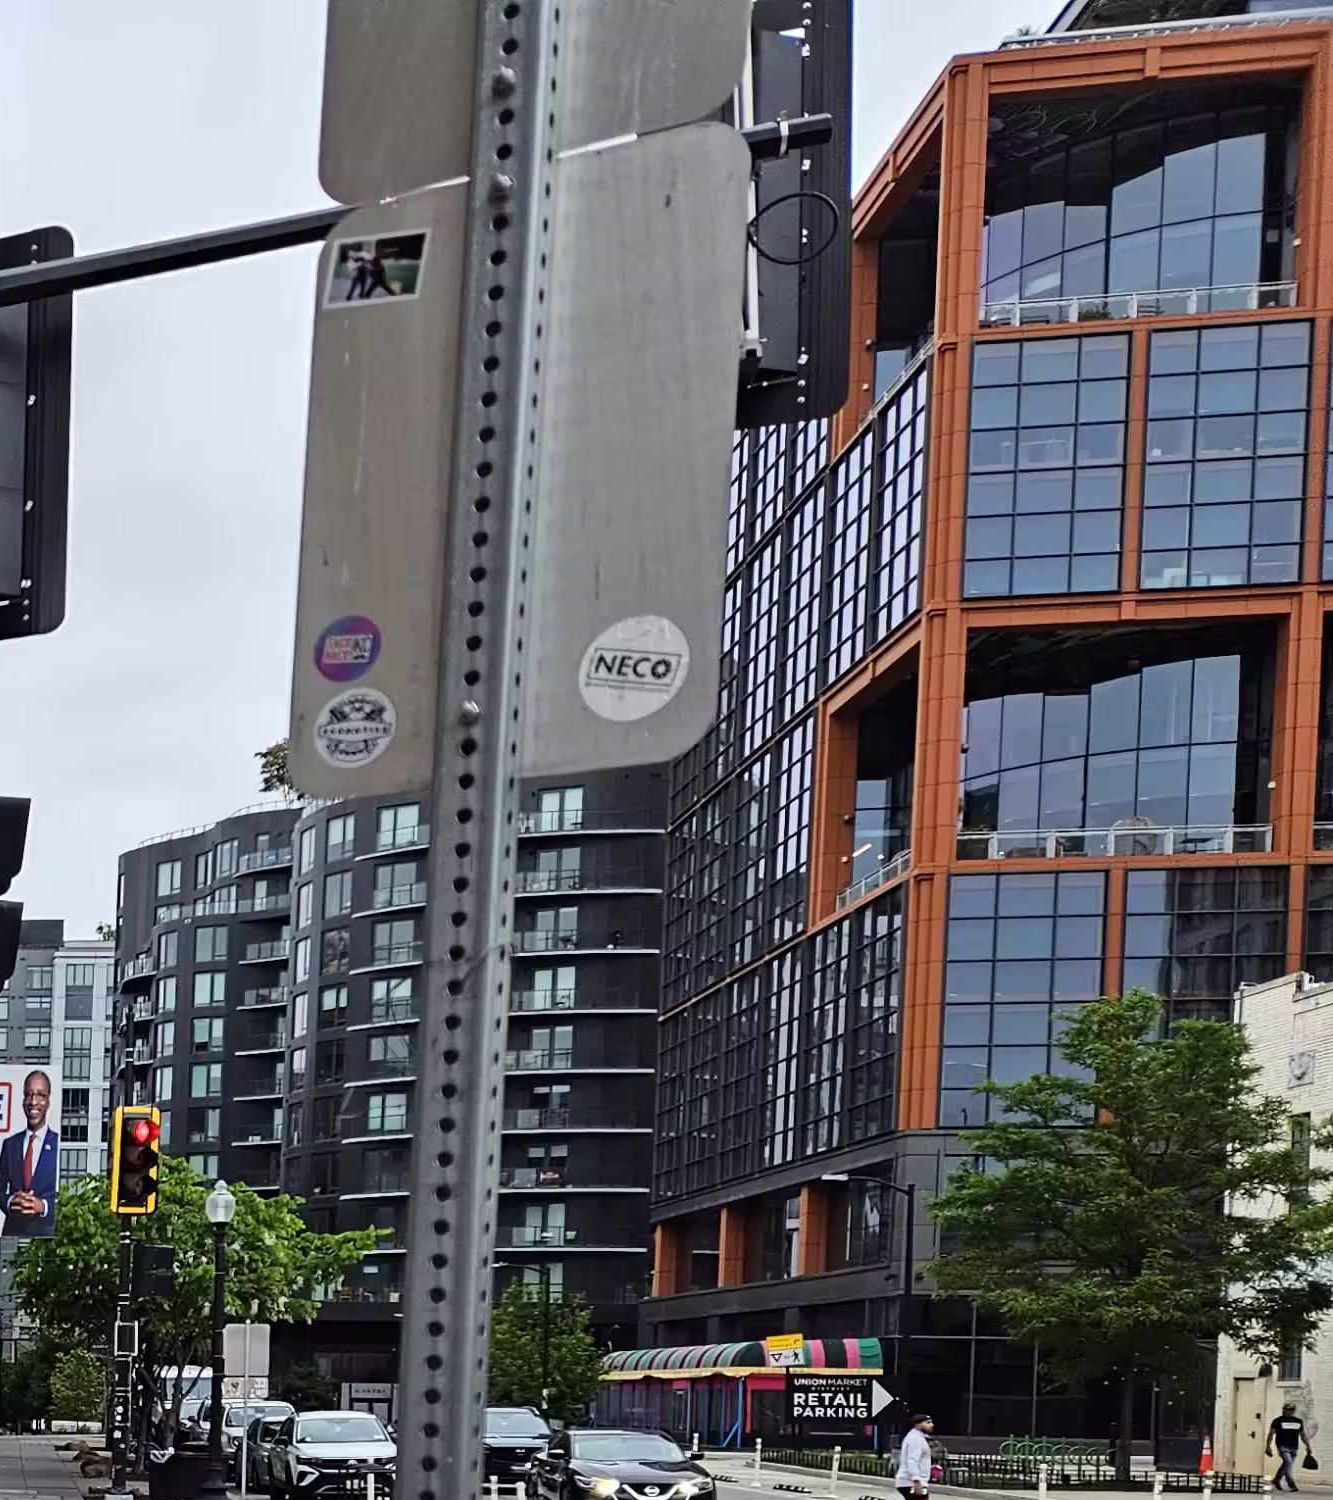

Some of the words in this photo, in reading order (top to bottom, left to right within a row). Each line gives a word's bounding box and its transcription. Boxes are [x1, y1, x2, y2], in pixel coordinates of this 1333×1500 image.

[594, 653, 672, 679] NECO
[794, 1378, 827, 1386] UNION
[827, 1378, 868, 1386] MARKET
[793, 1392, 868, 1407] RETAIL
[793, 1407, 868, 1418] PARKING
